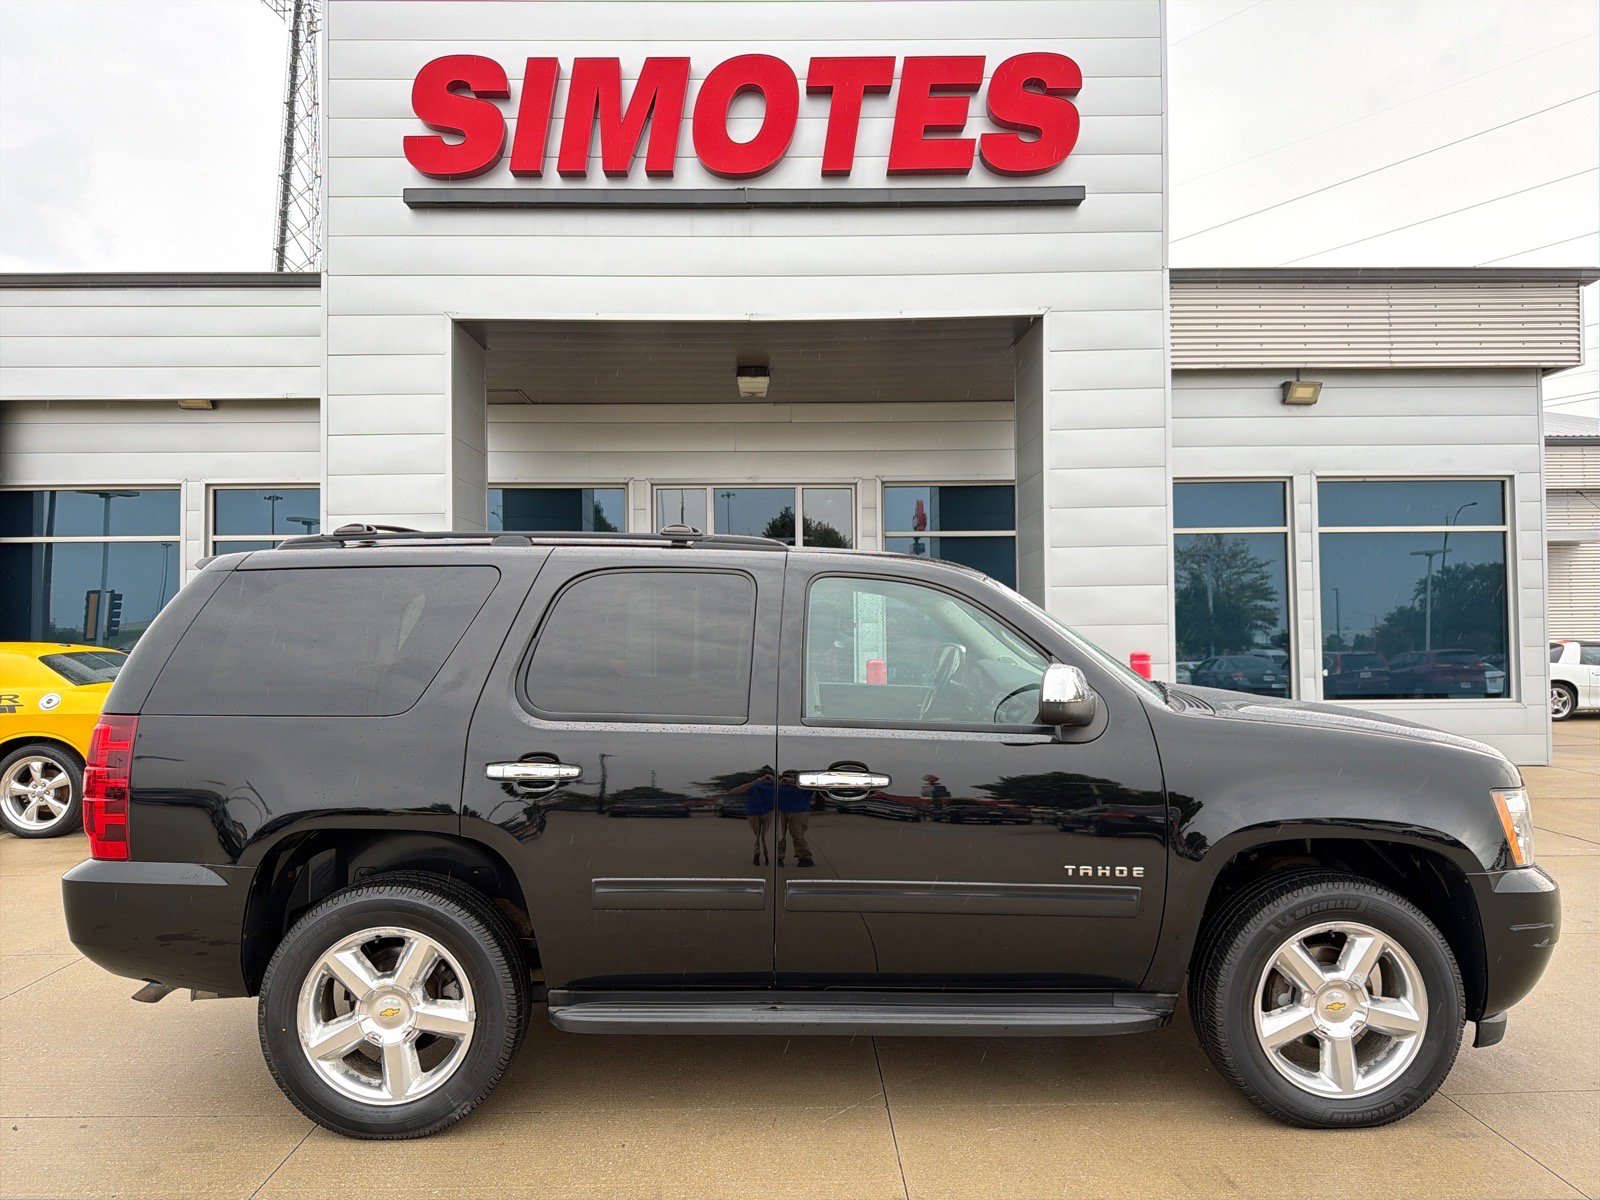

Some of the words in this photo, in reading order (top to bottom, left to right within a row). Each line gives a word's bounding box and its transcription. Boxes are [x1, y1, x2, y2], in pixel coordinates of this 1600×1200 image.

[403, 52, 1082, 180] SIMOTES
[1064, 865, 1145, 878] TAHOE
[1293, 899, 1362, 921] MICHELIN
